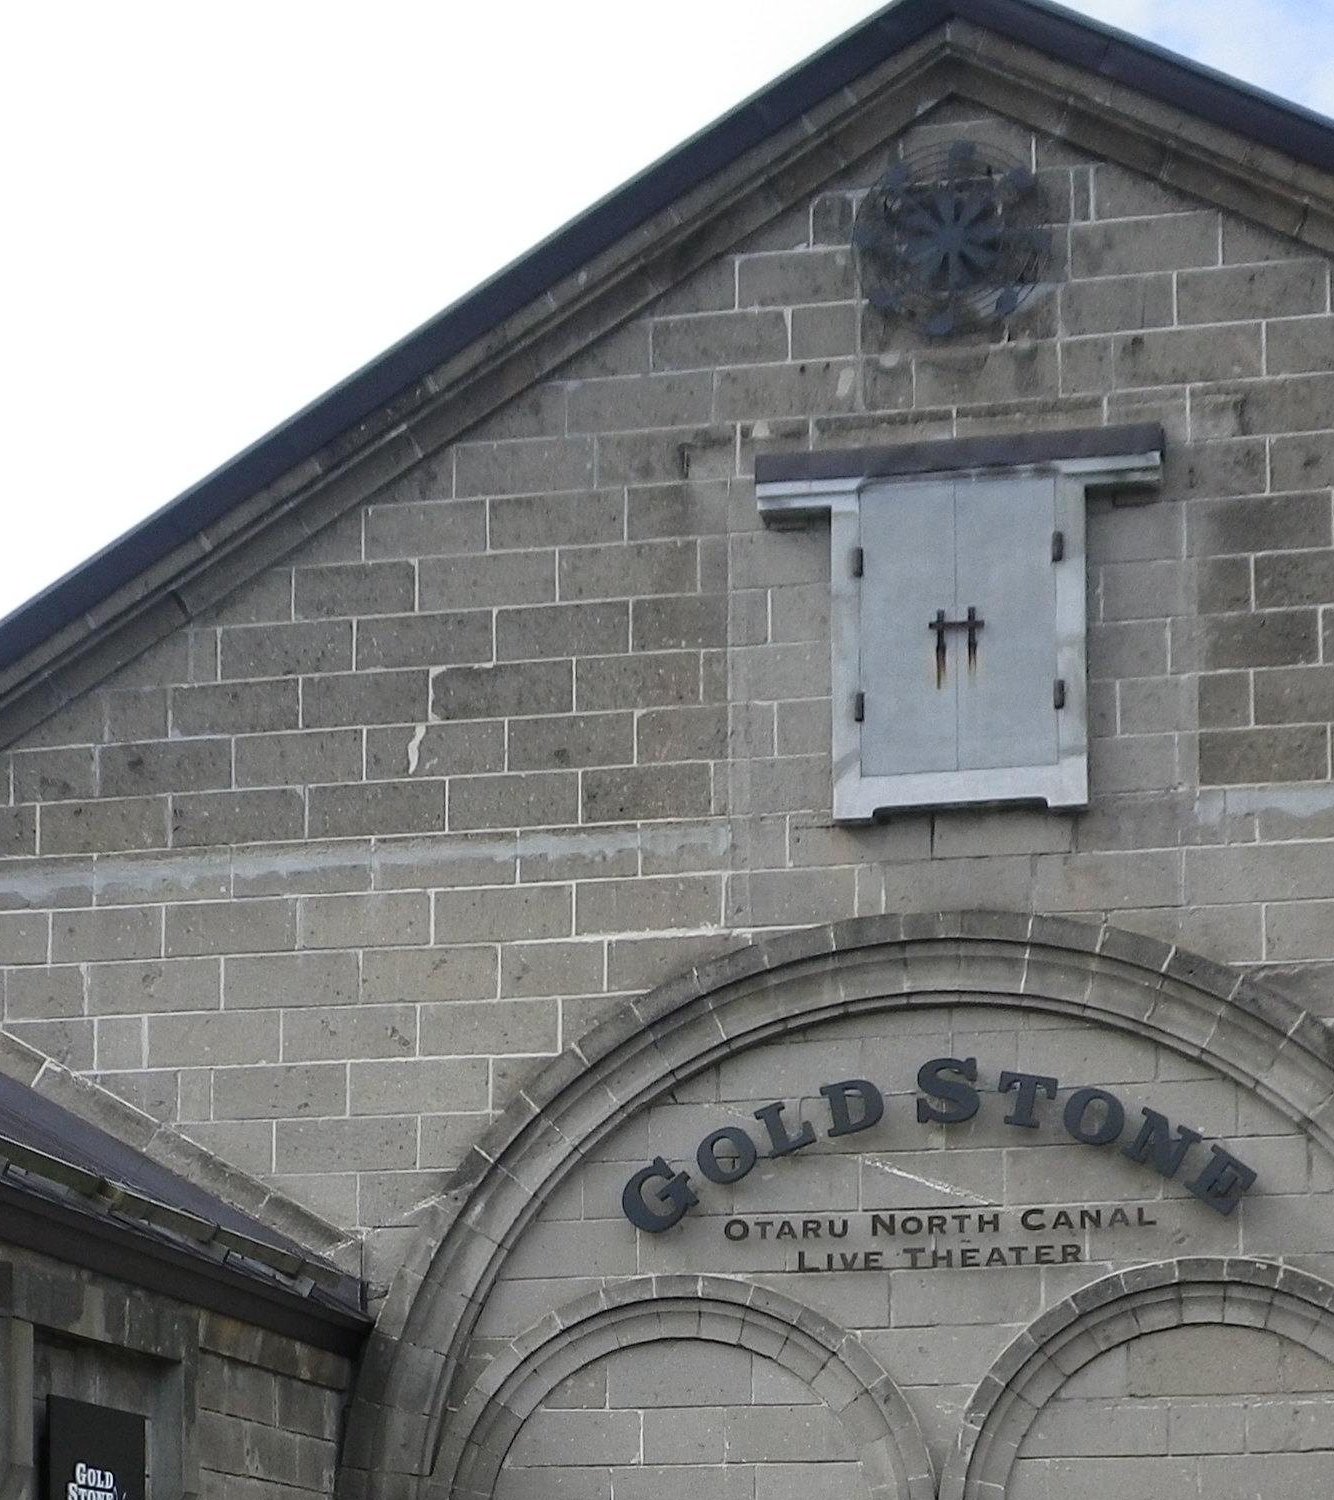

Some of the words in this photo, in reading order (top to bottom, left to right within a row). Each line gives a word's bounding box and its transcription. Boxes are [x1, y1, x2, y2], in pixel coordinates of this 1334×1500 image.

[622, 1079, 885, 1234] GOLD
[916, 1057, 1259, 1217] STONE
[723, 1217, 849, 1241] OTARU
[870, 1213, 1000, 1237] NORTH
[1020, 1206, 1158, 1231] CANAL
[797, 1250, 884, 1272] LIVE
[902, 1243, 1083, 1269] THEATER
[75, 1462, 114, 1490] GOLD
